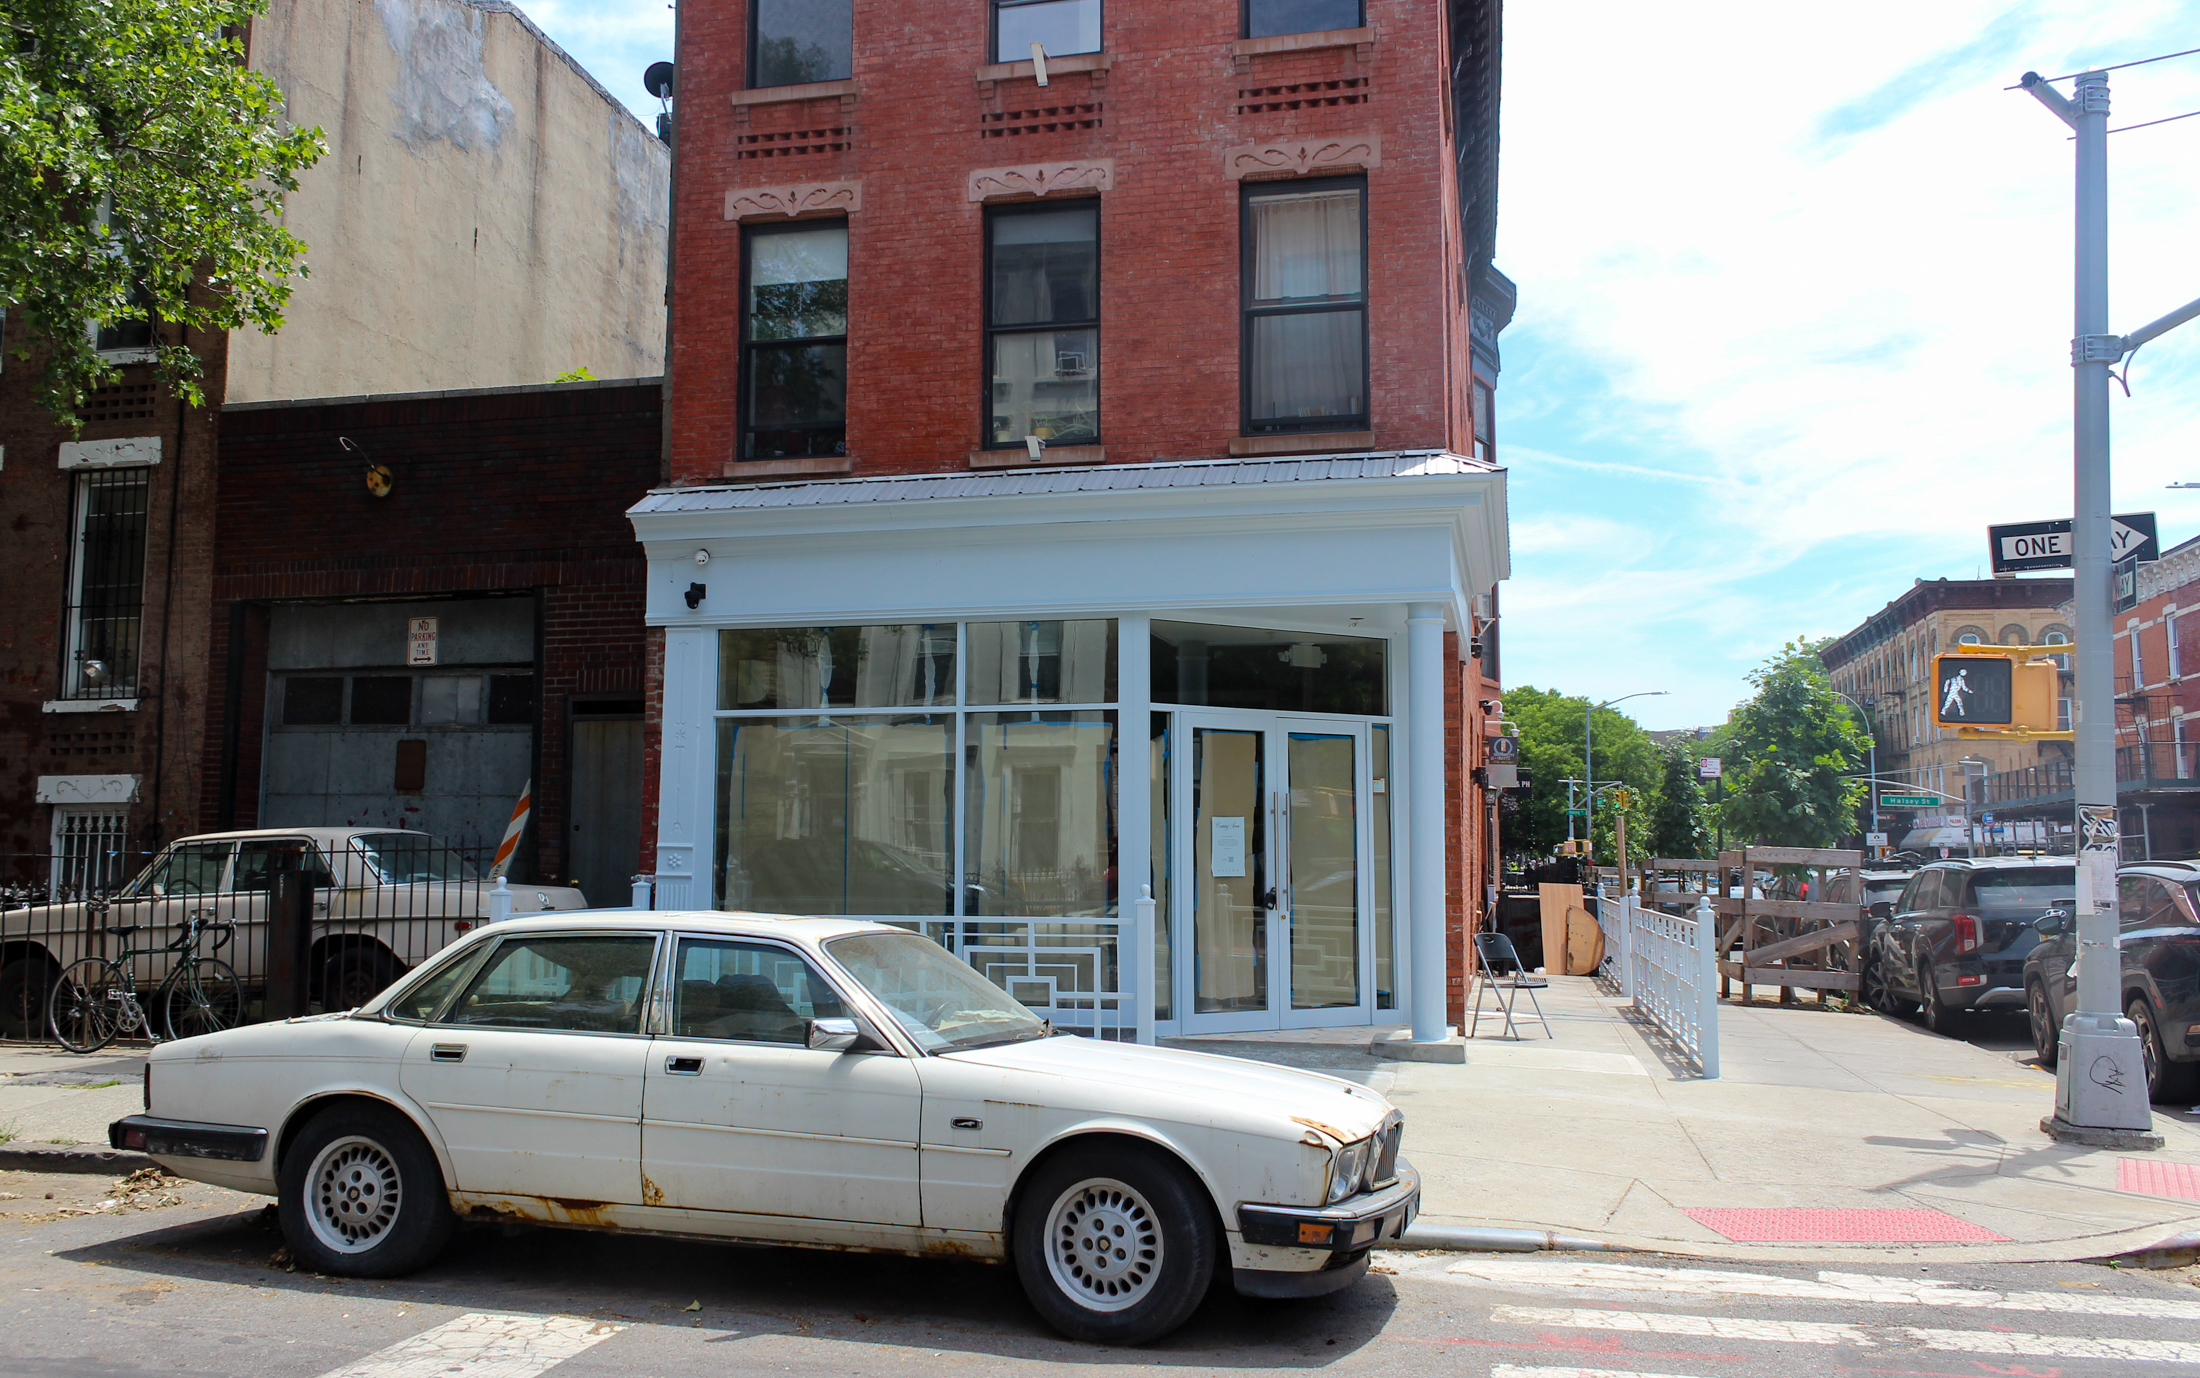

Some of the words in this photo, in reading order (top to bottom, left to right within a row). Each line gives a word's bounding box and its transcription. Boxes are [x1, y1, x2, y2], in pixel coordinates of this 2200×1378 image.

[2015, 535, 2062, 557] ONE
[418, 621, 430, 631] NO
[411, 632, 436, 642] PARKING
[1890, 797, 1920, 805] Halsey
